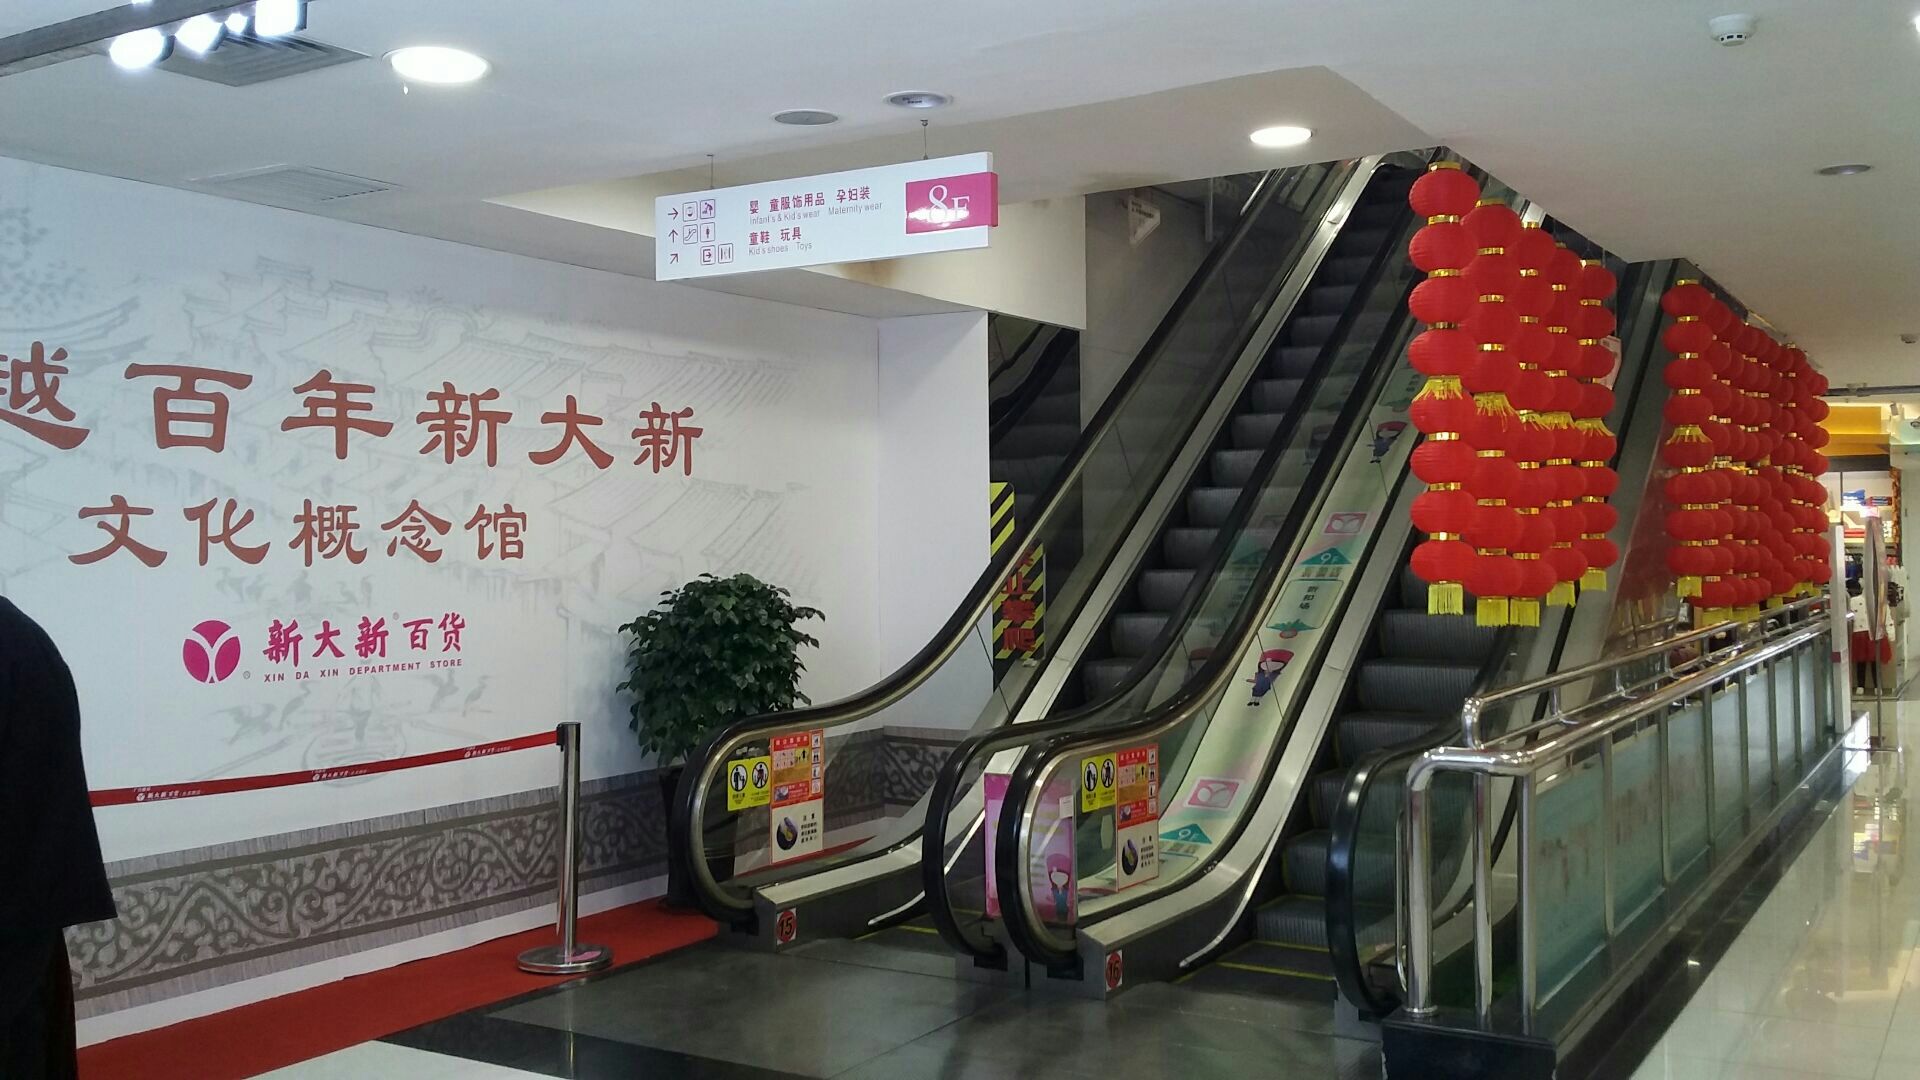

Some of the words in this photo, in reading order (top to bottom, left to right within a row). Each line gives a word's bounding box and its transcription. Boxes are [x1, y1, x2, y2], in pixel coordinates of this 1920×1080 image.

[749, 200, 760, 215] 婴
[769, 191, 826, 213] 童服饰用品
[836, 186, 872, 204] 孕妇装
[803, 210, 820, 219] wear
[828, 203, 863, 216] Maternity
[864, 202, 883, 212] wear
[929, 184, 970, 222] 8F
[749, 230, 770, 246] 童鞋
[780, 226, 802, 242] 玩具
[767, 244, 789, 254] shoes
[796, 241, 813, 252] Toys
[68, 494, 528, 568] 文化概念馆
[263, 672, 285, 683] XIN
[295, 670, 310, 680] DA
[319, 667, 340, 678] XIN
[349, 662, 421, 676] DEPARTMENT
[429, 658, 463, 669] STORE
[780, 916, 793, 937] 15
